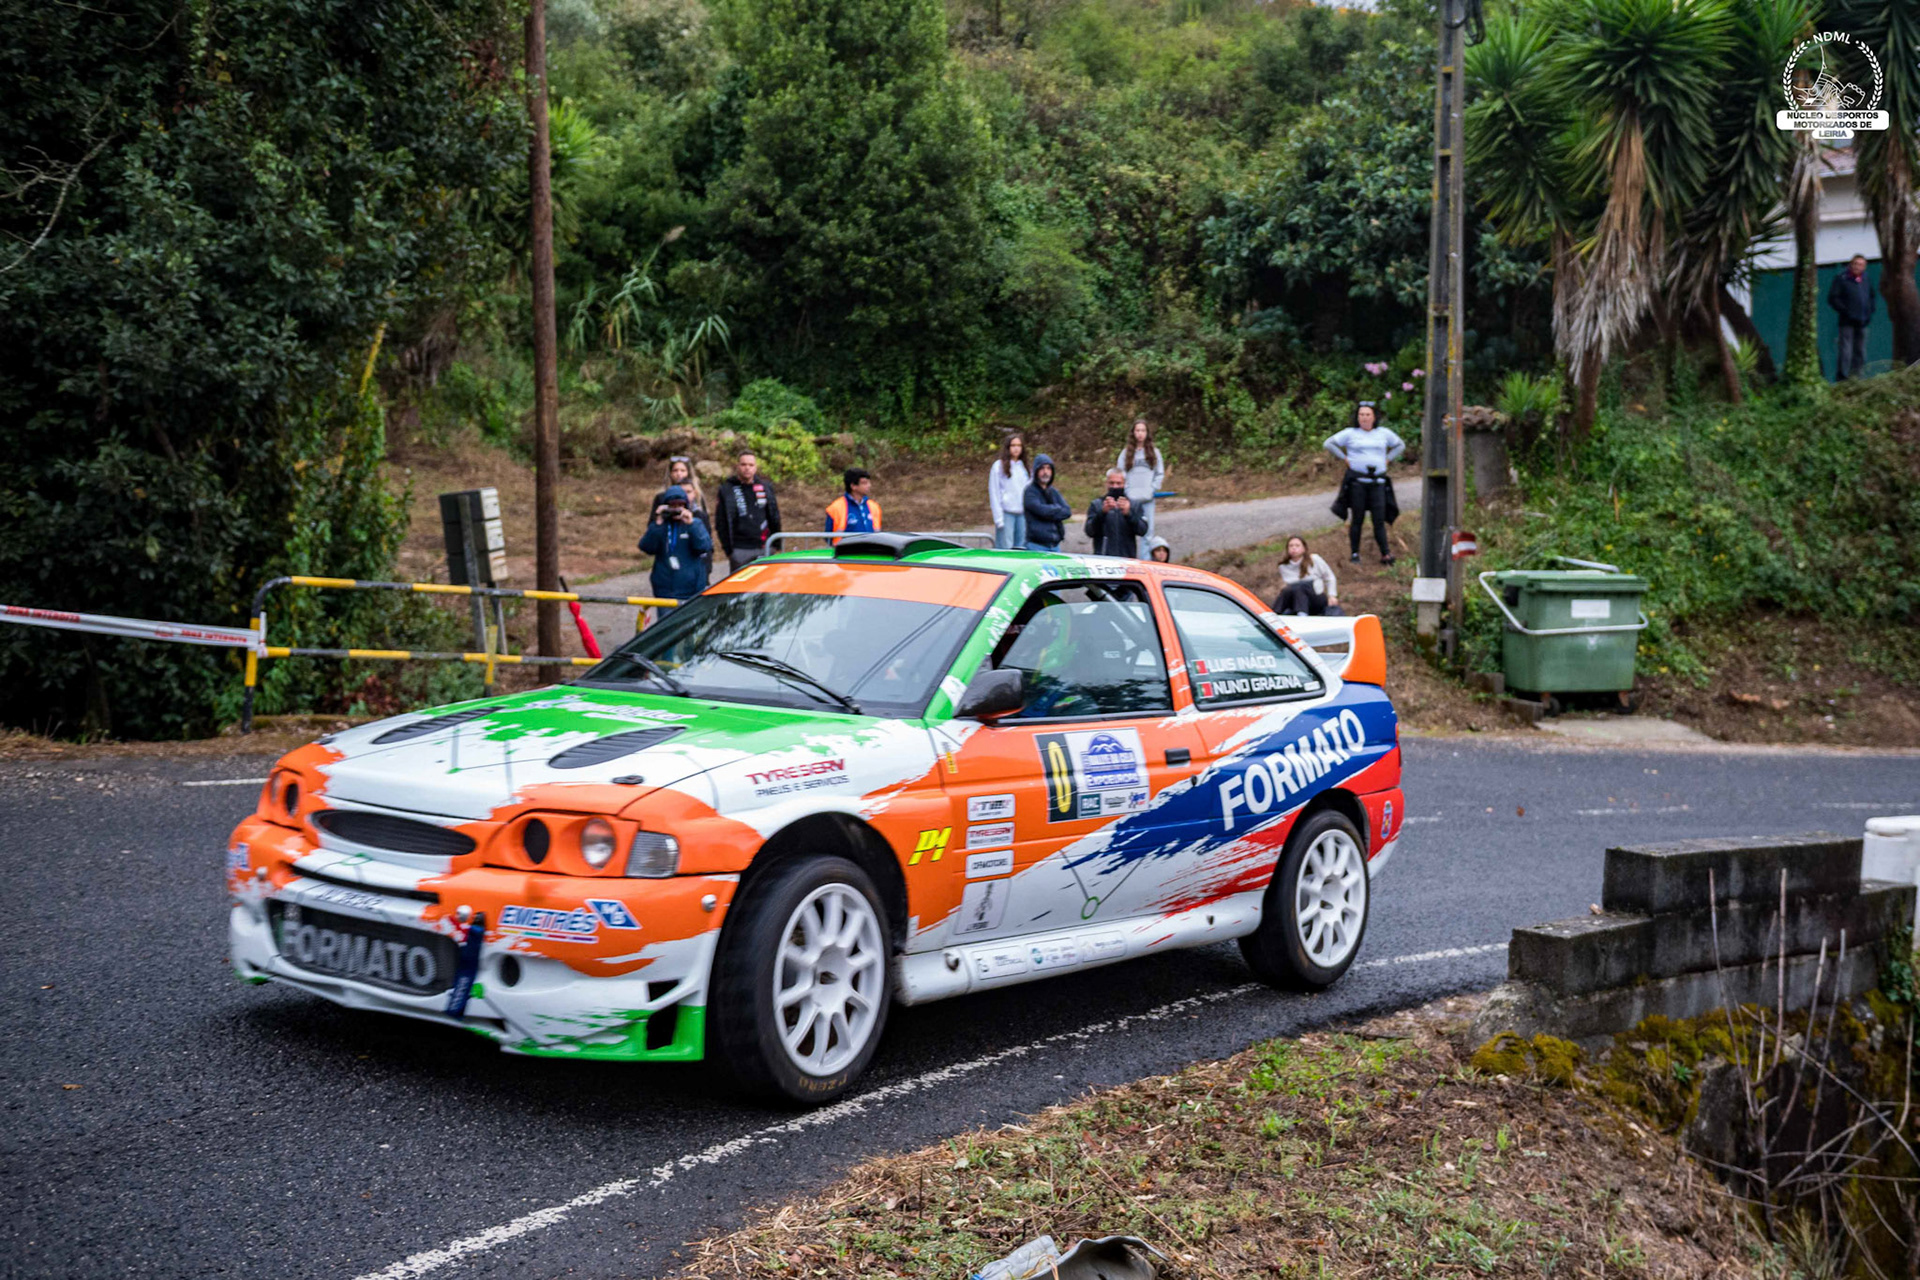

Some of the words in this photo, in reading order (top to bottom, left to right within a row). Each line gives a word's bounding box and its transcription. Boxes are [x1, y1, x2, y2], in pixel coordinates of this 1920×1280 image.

[1057, 564, 1094, 575] Team
[1097, 564, 1147, 576] Formato
[1207, 657, 1236, 673] LUIS
[1237, 653, 1277, 669] INÁCIO
[1213, 679, 1250, 695] NUNO
[1252, 675, 1302, 692] GRAZINA
[745, 759, 845, 784] TYRESERV
[1218, 709, 1366, 831] FORMATO
[502, 906, 598, 933] EMETRÉS
[282, 920, 437, 986] FORMATO
